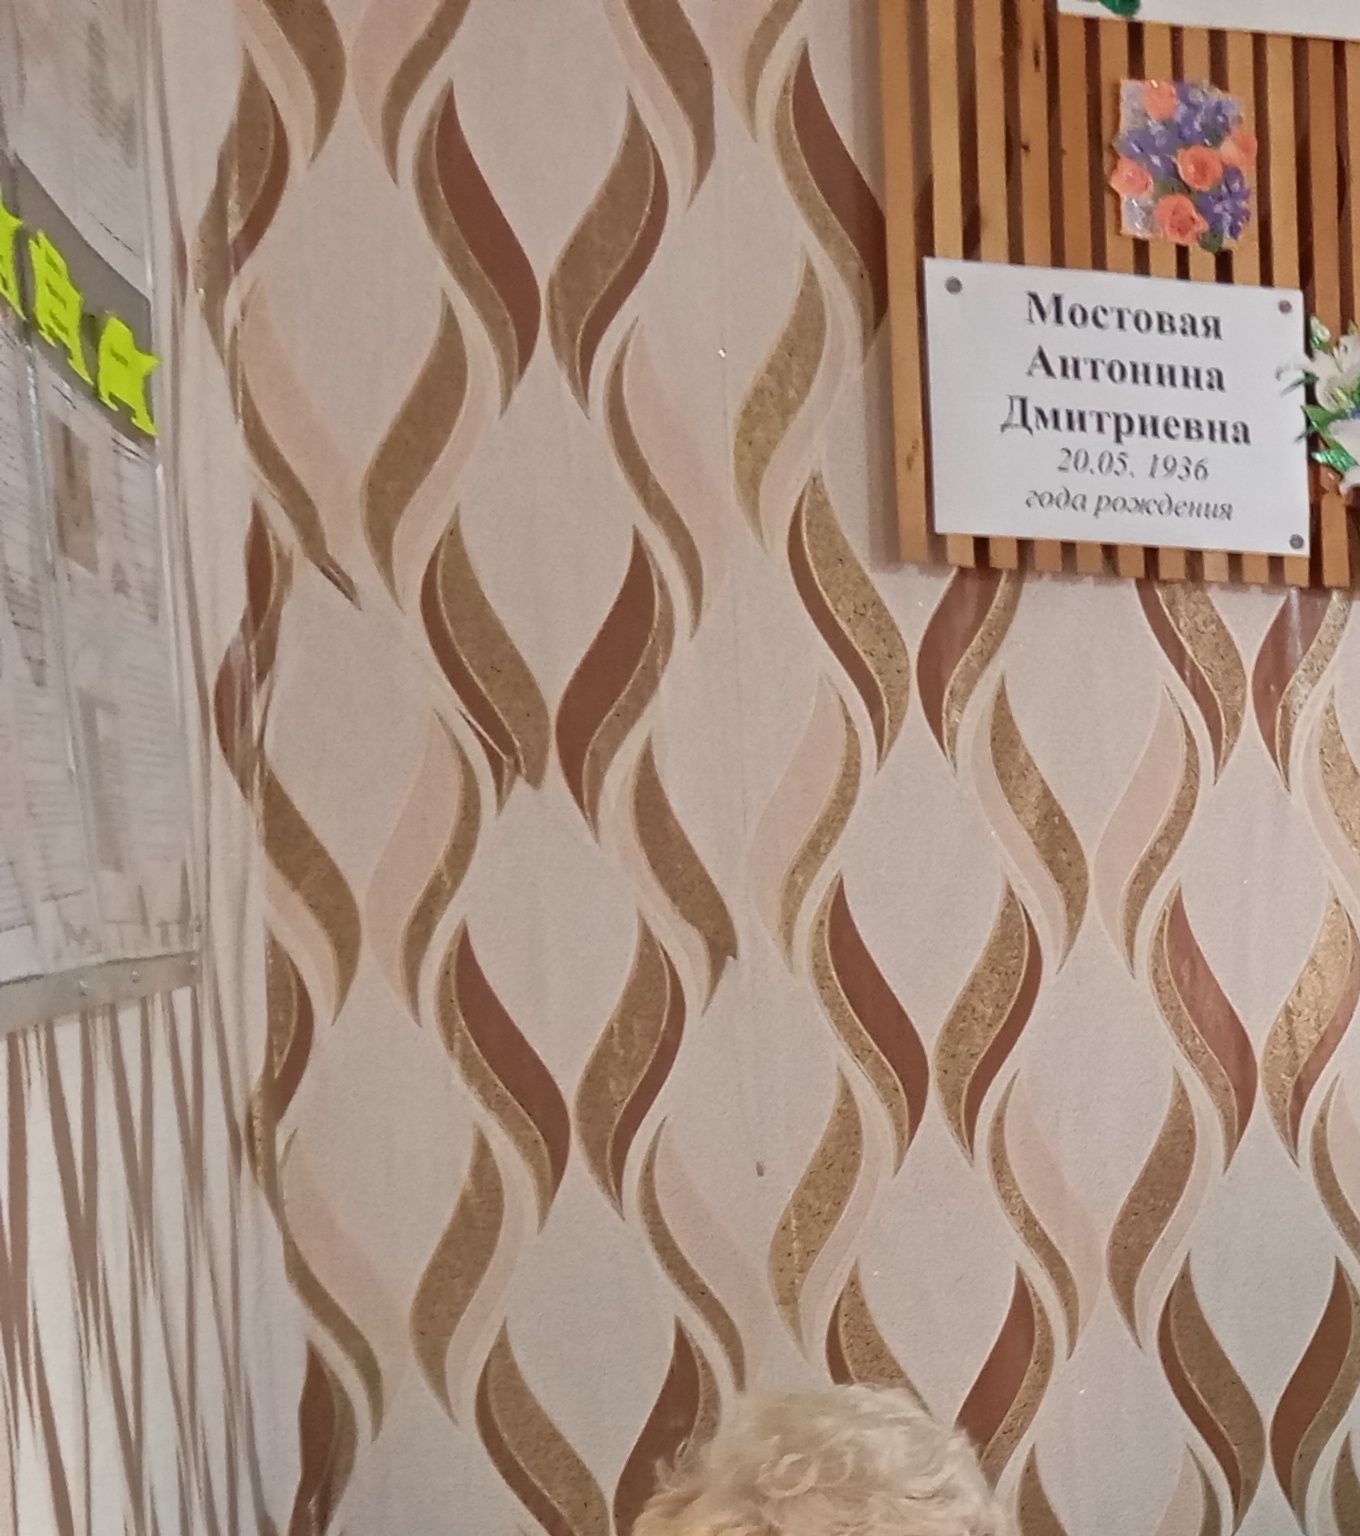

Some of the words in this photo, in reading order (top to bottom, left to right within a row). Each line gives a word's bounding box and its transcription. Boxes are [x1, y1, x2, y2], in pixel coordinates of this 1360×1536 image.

[1026, 291, 1223, 341] Мостовая
[1026, 344, 1226, 392] Антонина
[1000, 394, 1252, 446] Дмитриевна
[1057, 448, 1139, 480] 20.05.
[1148, 452, 1209, 483] 1936
[1025, 486, 1088, 513] года
[1094, 492, 1233, 521] рождения
